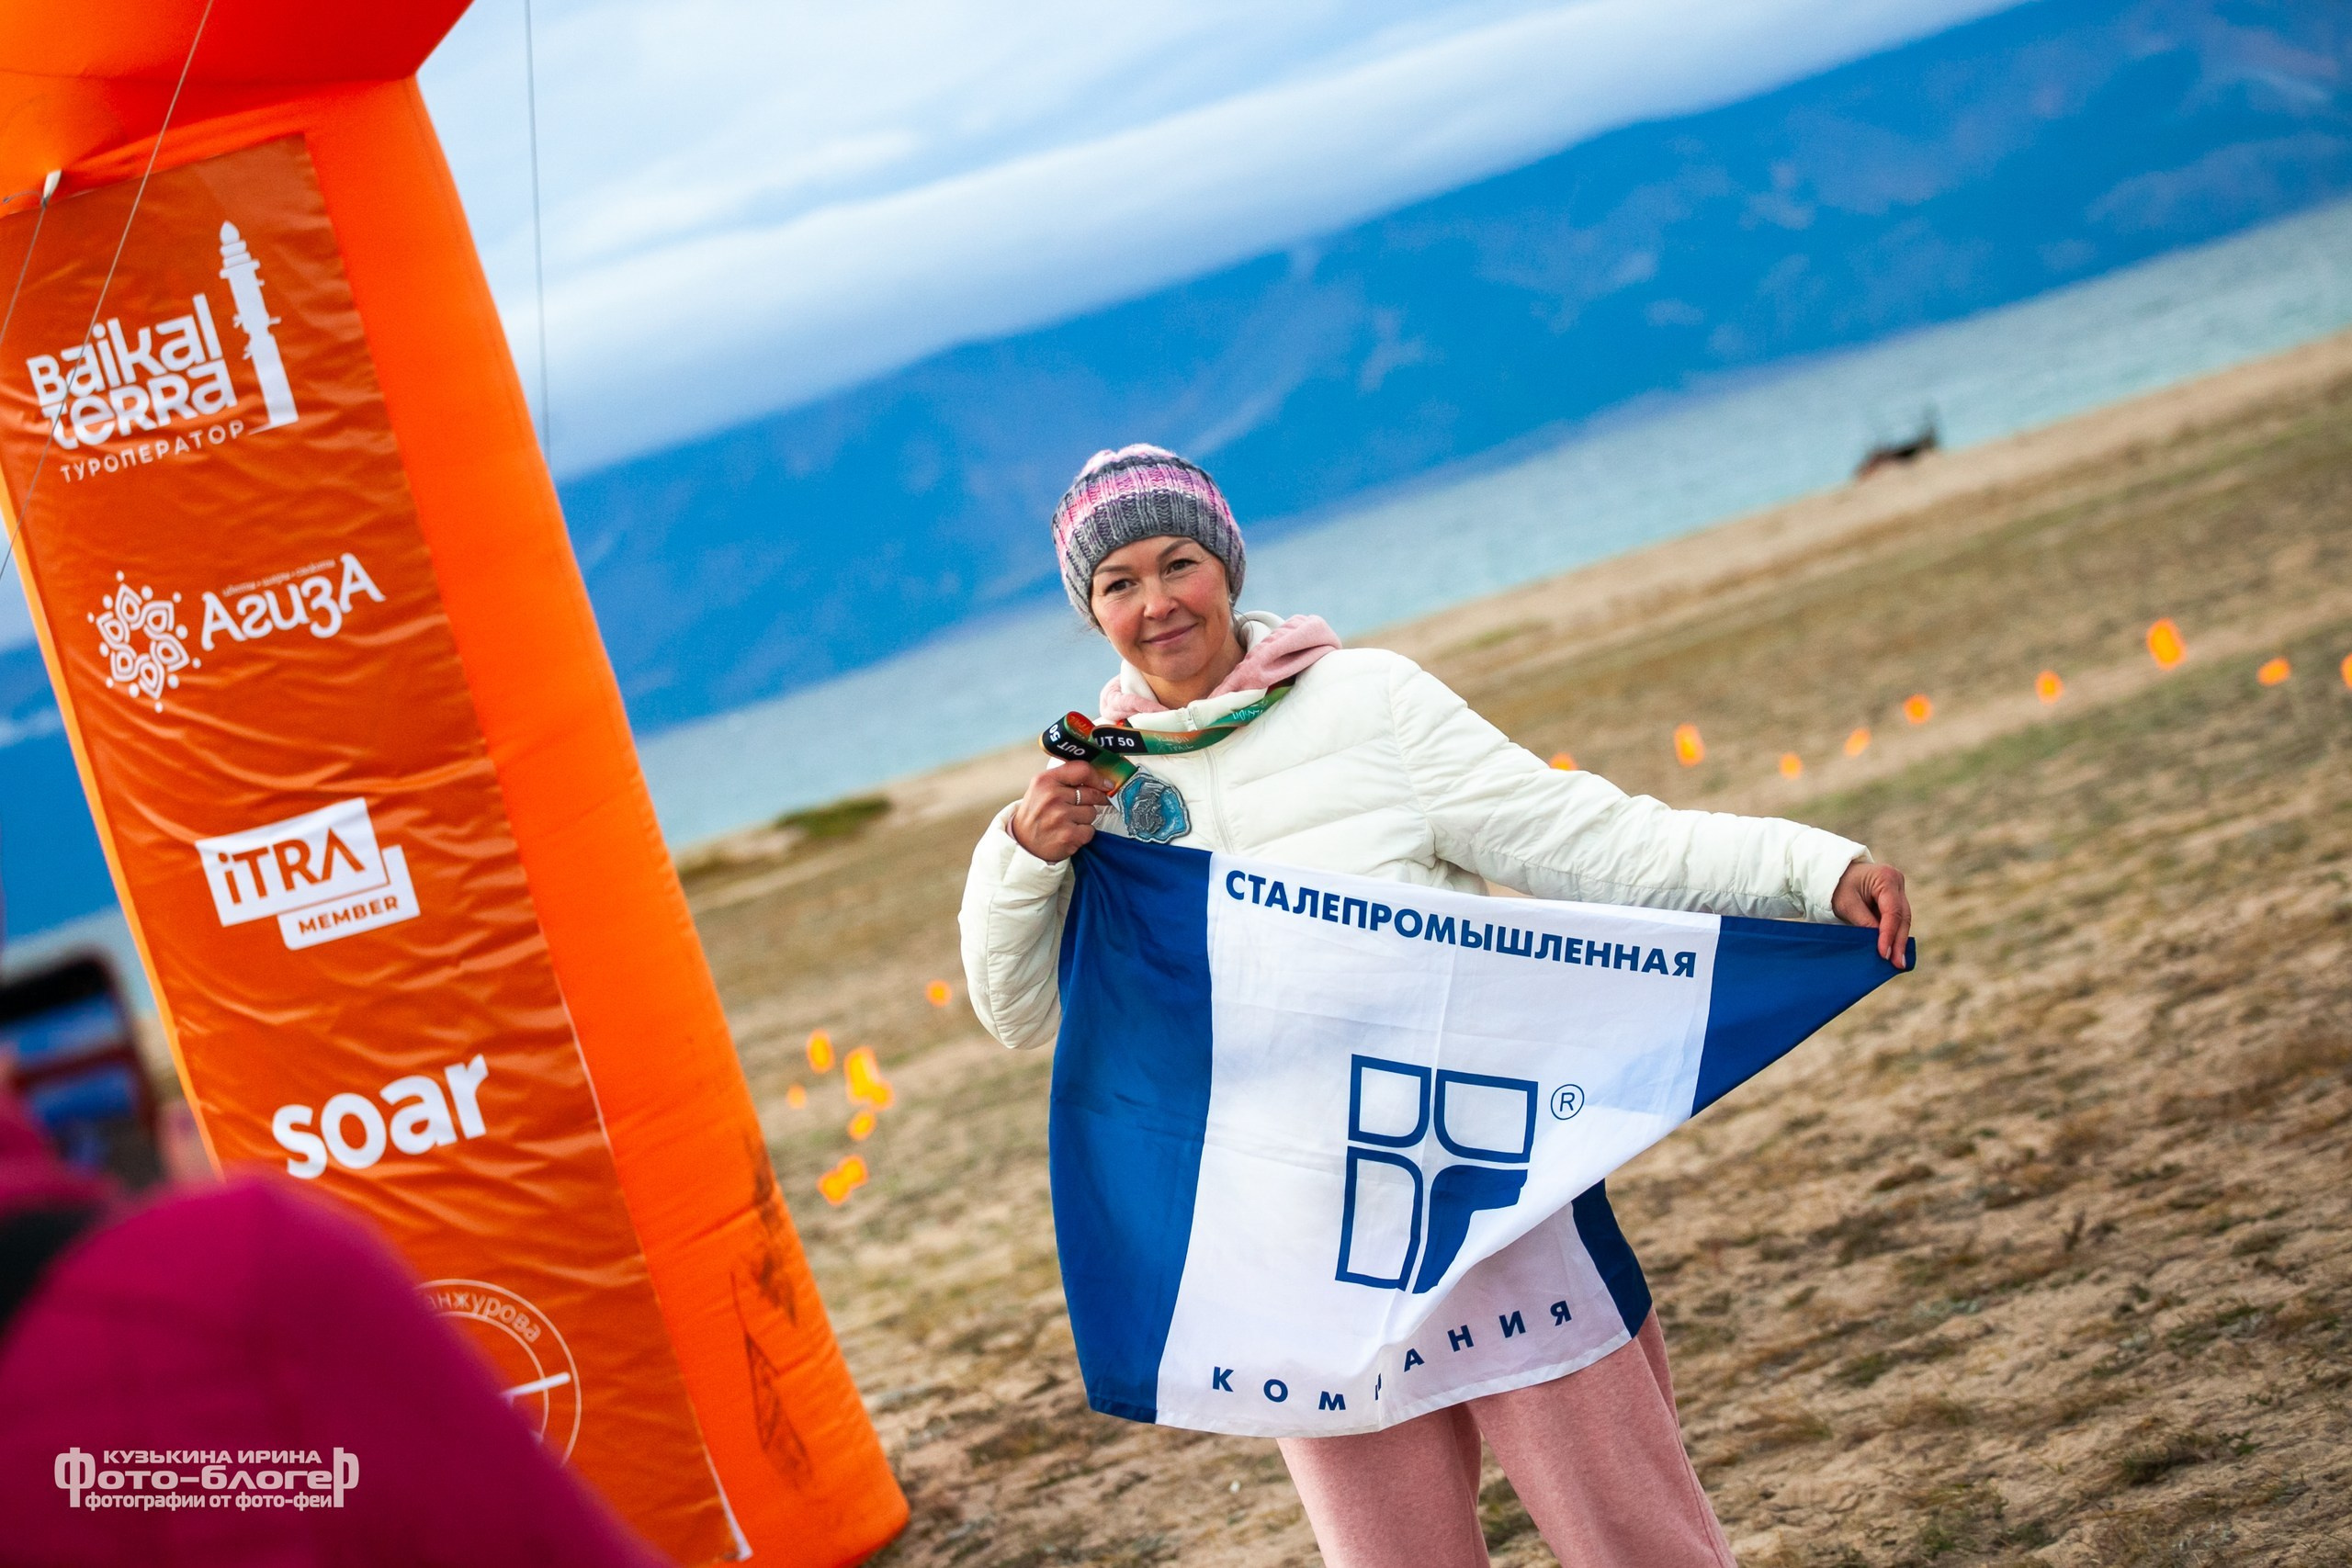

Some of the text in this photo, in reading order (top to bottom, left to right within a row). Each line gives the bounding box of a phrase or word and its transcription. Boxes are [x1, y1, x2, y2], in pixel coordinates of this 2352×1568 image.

[60, 420, 243, 483] ТУРОПЕРАТОР
[1049, 724, 1061, 742] 50
[1057, 741, 1086, 756] OUT
[1095, 737, 1135, 747] UT 50
[298, 895, 399, 935] MEMBER
[1226, 870, 1697, 978] СТАЛЕПРОМЫШЛЕННАЯ
[272, 1054, 489, 1179] soar
